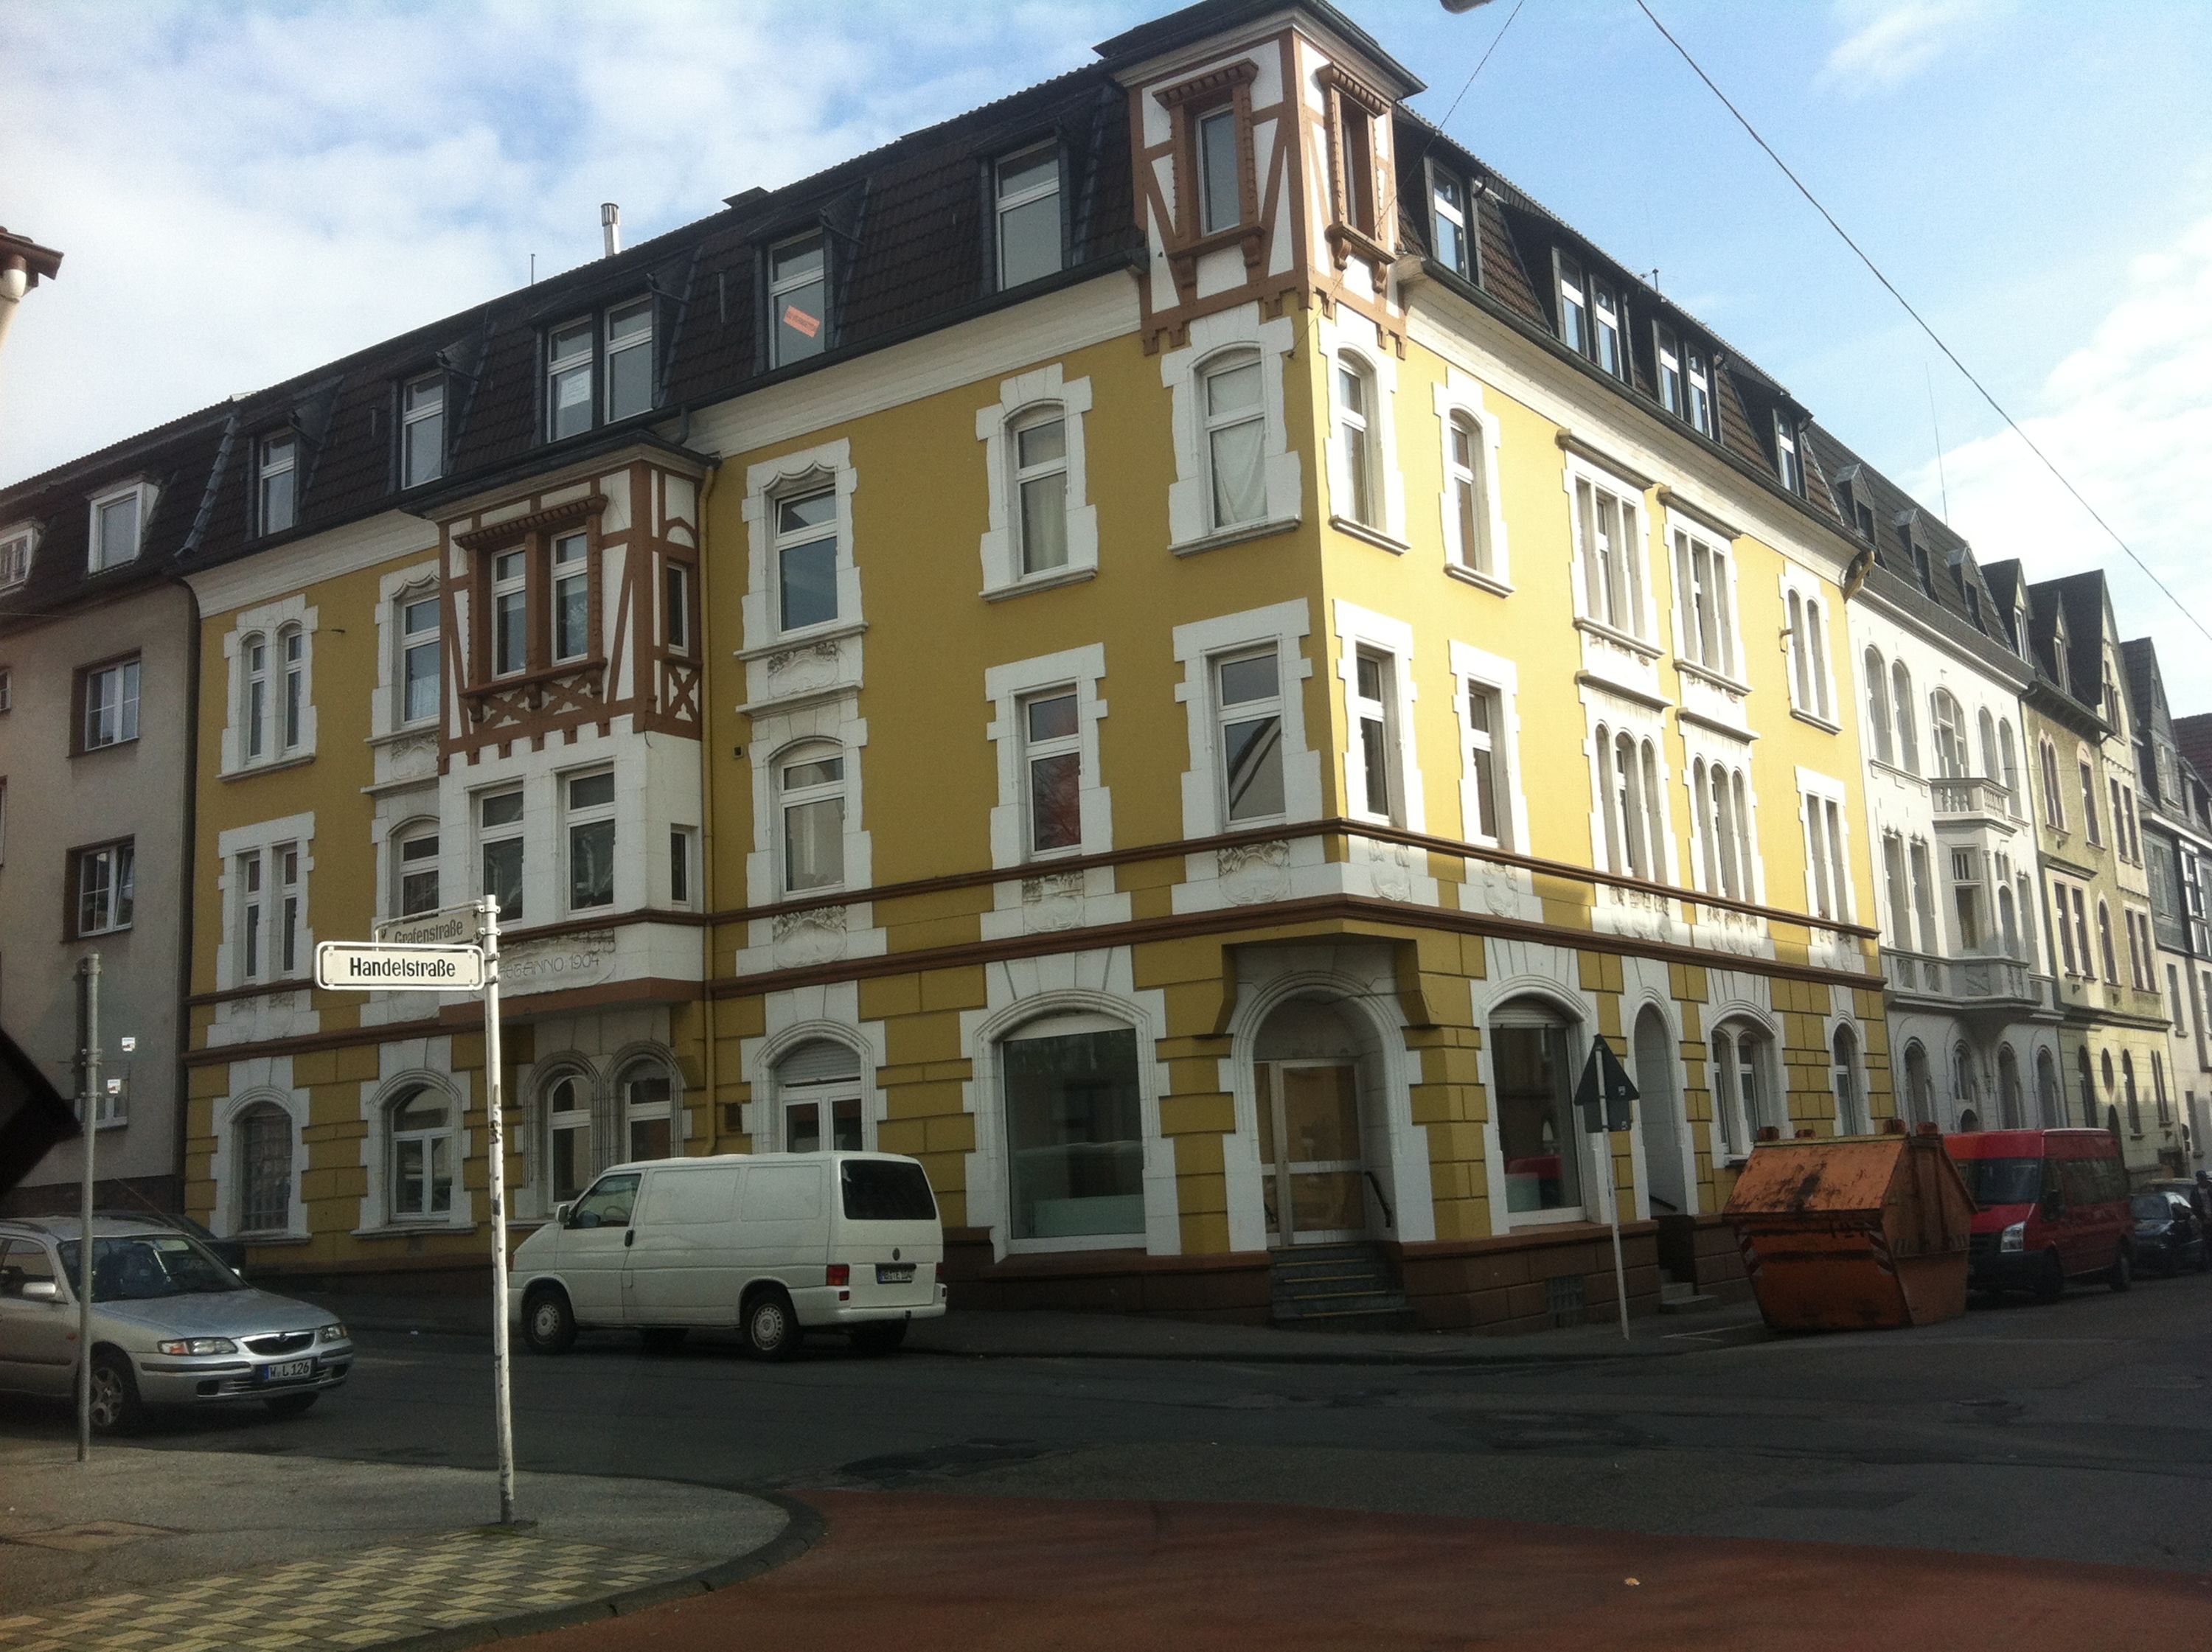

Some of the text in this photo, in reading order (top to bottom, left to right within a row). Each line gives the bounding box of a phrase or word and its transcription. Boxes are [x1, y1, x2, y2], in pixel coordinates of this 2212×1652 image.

[394, 919, 463, 944] Grafenstraße
[349, 957, 456, 977] Handelstraße
[568, 953, 599, 970] 1904
